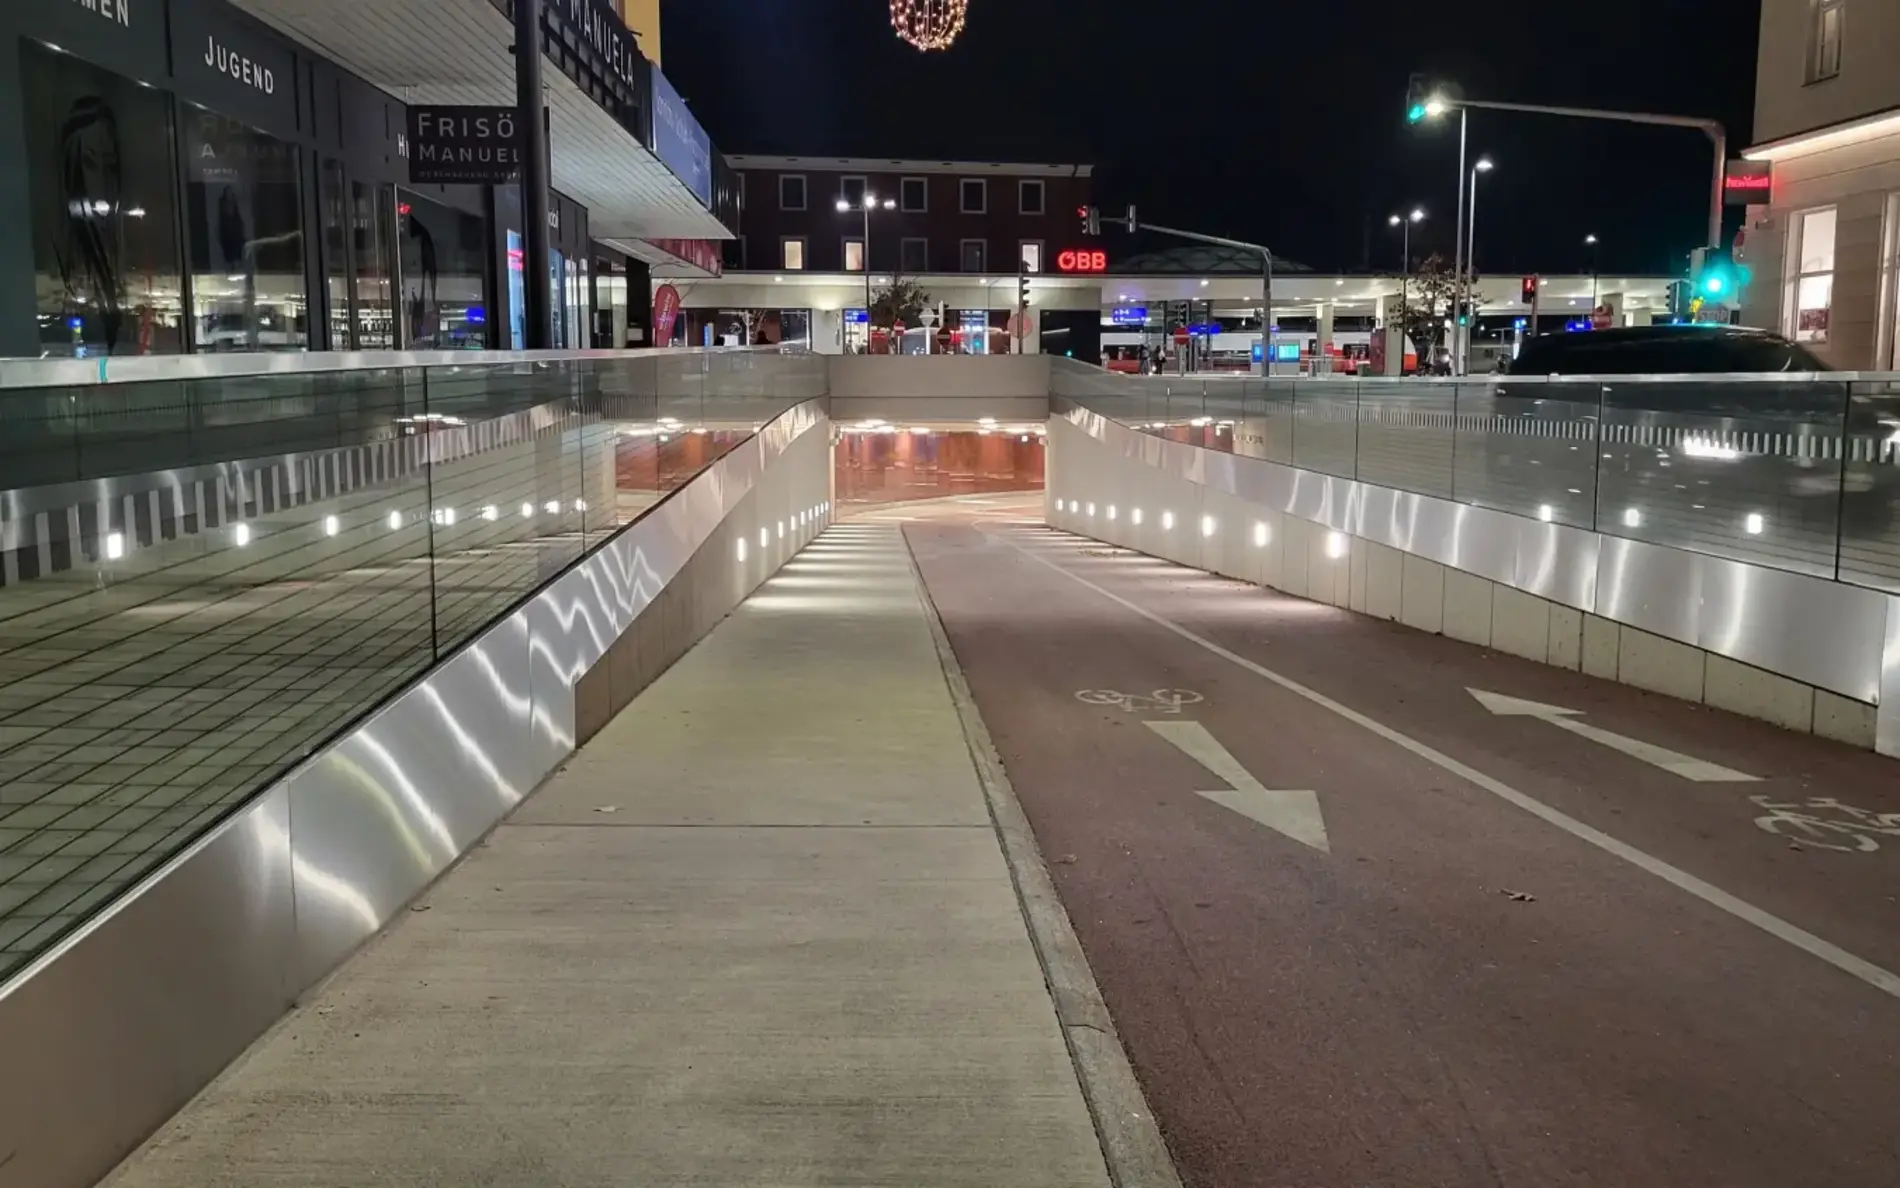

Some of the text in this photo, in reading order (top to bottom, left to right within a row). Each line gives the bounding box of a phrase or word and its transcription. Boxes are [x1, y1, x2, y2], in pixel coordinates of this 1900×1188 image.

[570, 0, 635, 91] MANUELA
[204, 35, 274, 94] JUGEND
[417, 112, 515, 138] FRISÖ
[418, 143, 519, 163] MANUEL
[1058, 251, 1106, 270] ÖBB
